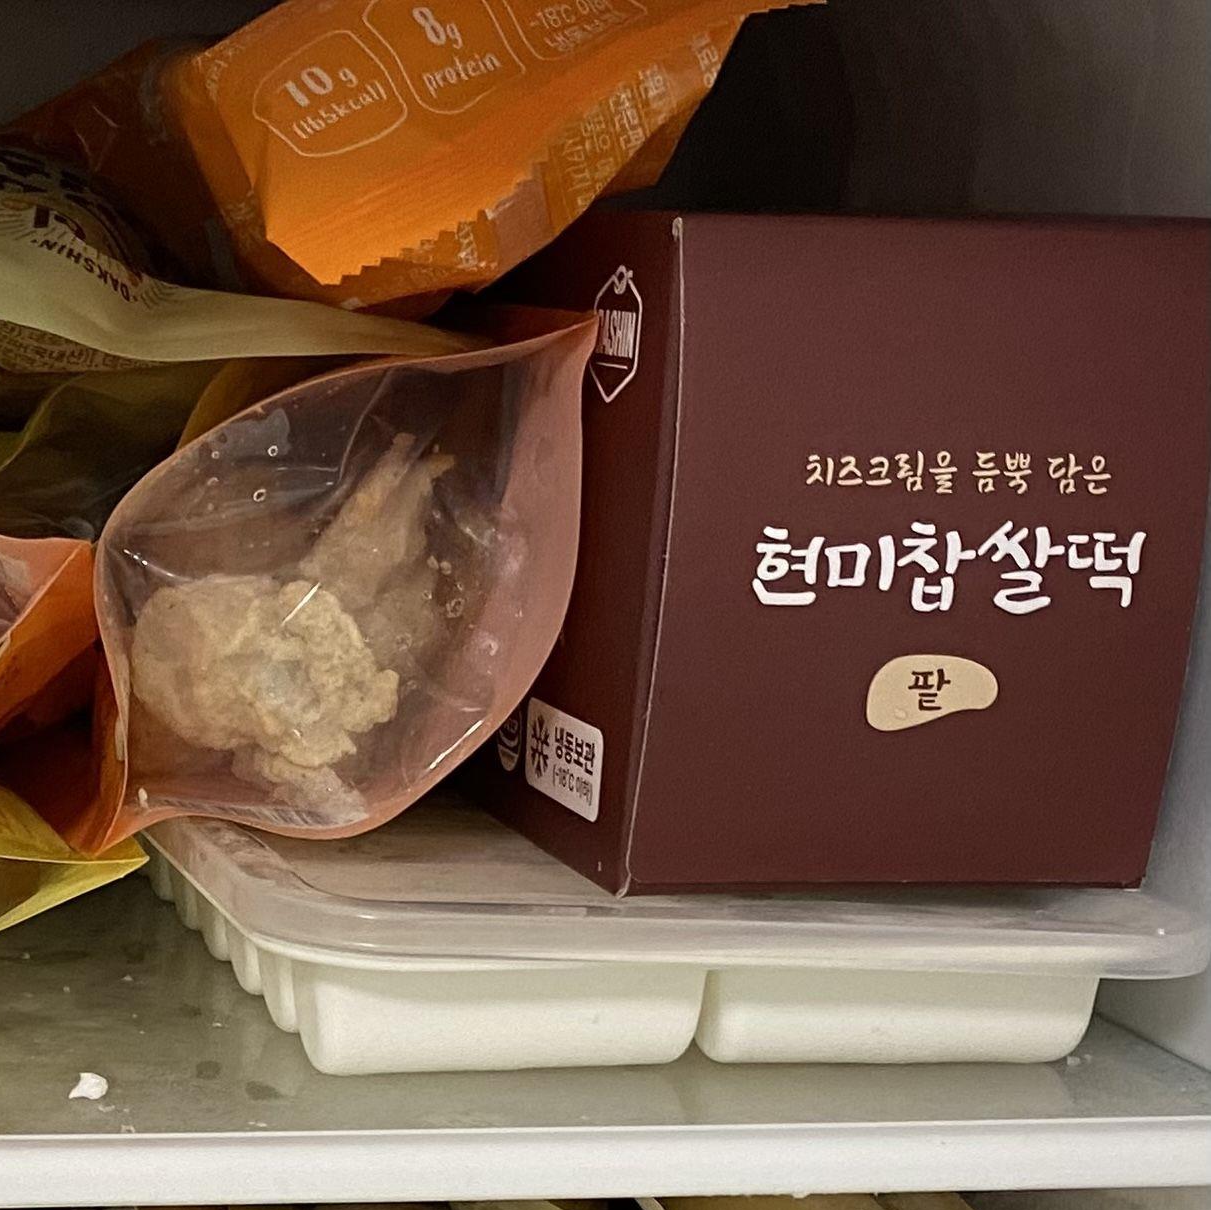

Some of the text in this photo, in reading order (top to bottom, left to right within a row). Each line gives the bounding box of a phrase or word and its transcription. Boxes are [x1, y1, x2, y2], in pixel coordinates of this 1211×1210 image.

[422, 52, 502, 98] protein
[39, 238, 131, 302] DAKSHIN
[805, 450, 1112, 496] 치즈크림을 듬뿍 담은
[752, 520, 1147, 615] 현미찹쌀떡
[907, 667, 951, 712] 팥
[554, 726, 596, 777] 냉동보관
